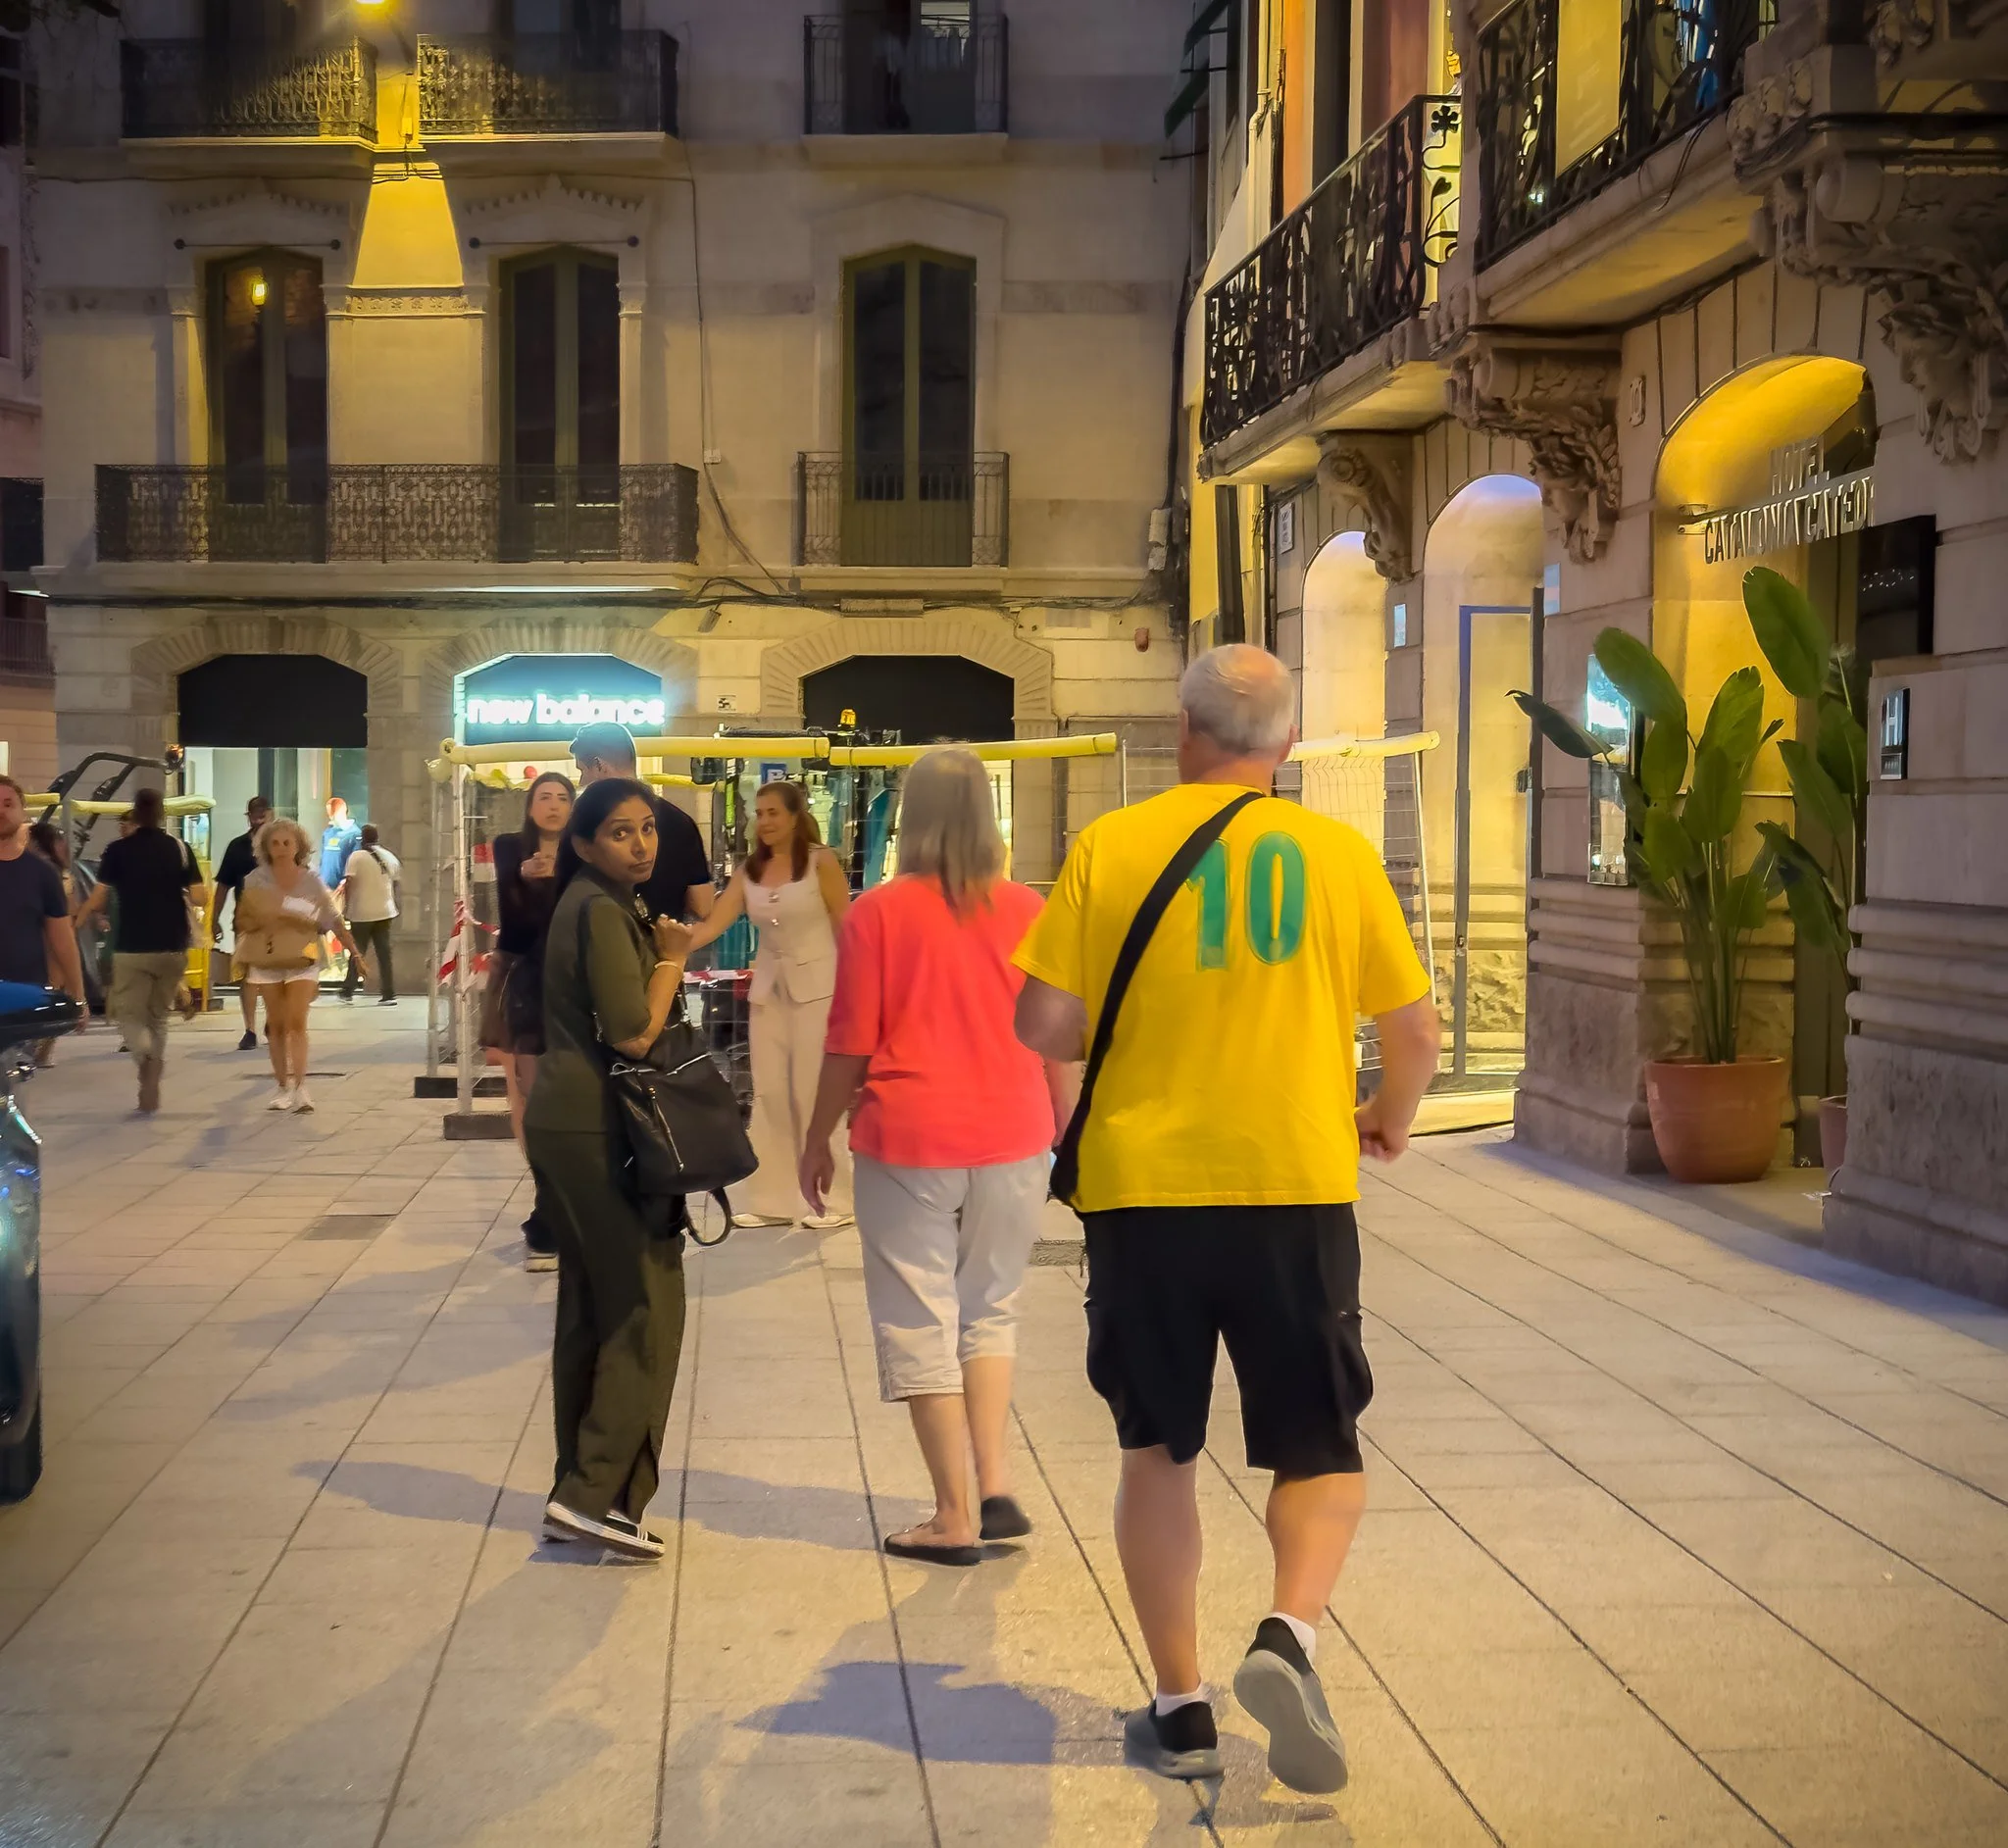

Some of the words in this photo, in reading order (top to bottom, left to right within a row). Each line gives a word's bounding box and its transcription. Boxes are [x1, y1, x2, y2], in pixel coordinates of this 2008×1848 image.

[466, 697, 532, 725] new
[535, 692, 667, 725] balance
[1183, 830, 1307, 970] 10
